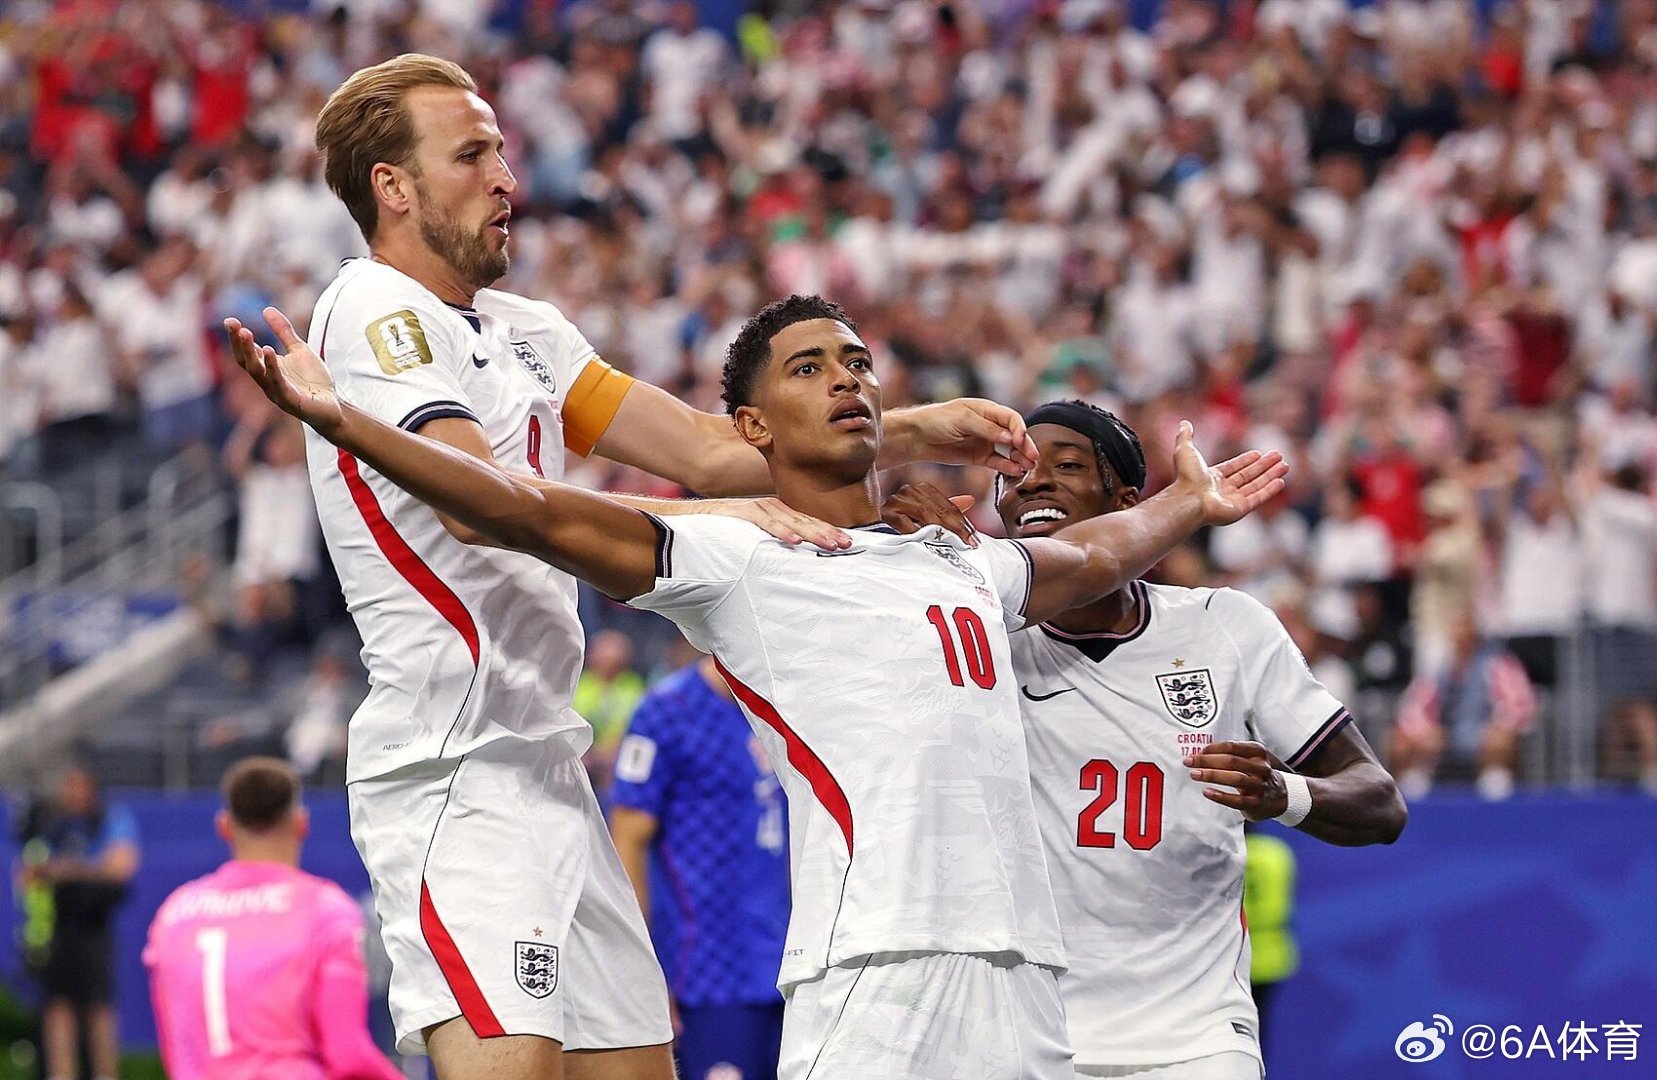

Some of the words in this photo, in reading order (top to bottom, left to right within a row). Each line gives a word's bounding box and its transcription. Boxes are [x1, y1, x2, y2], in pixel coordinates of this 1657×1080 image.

[527, 414, 545, 479] 9
[925, 604, 997, 691] 10
[1177, 733, 1213, 745] CROATIA
[1076, 758, 1165, 850] 20
[195, 926, 233, 1058] 1
